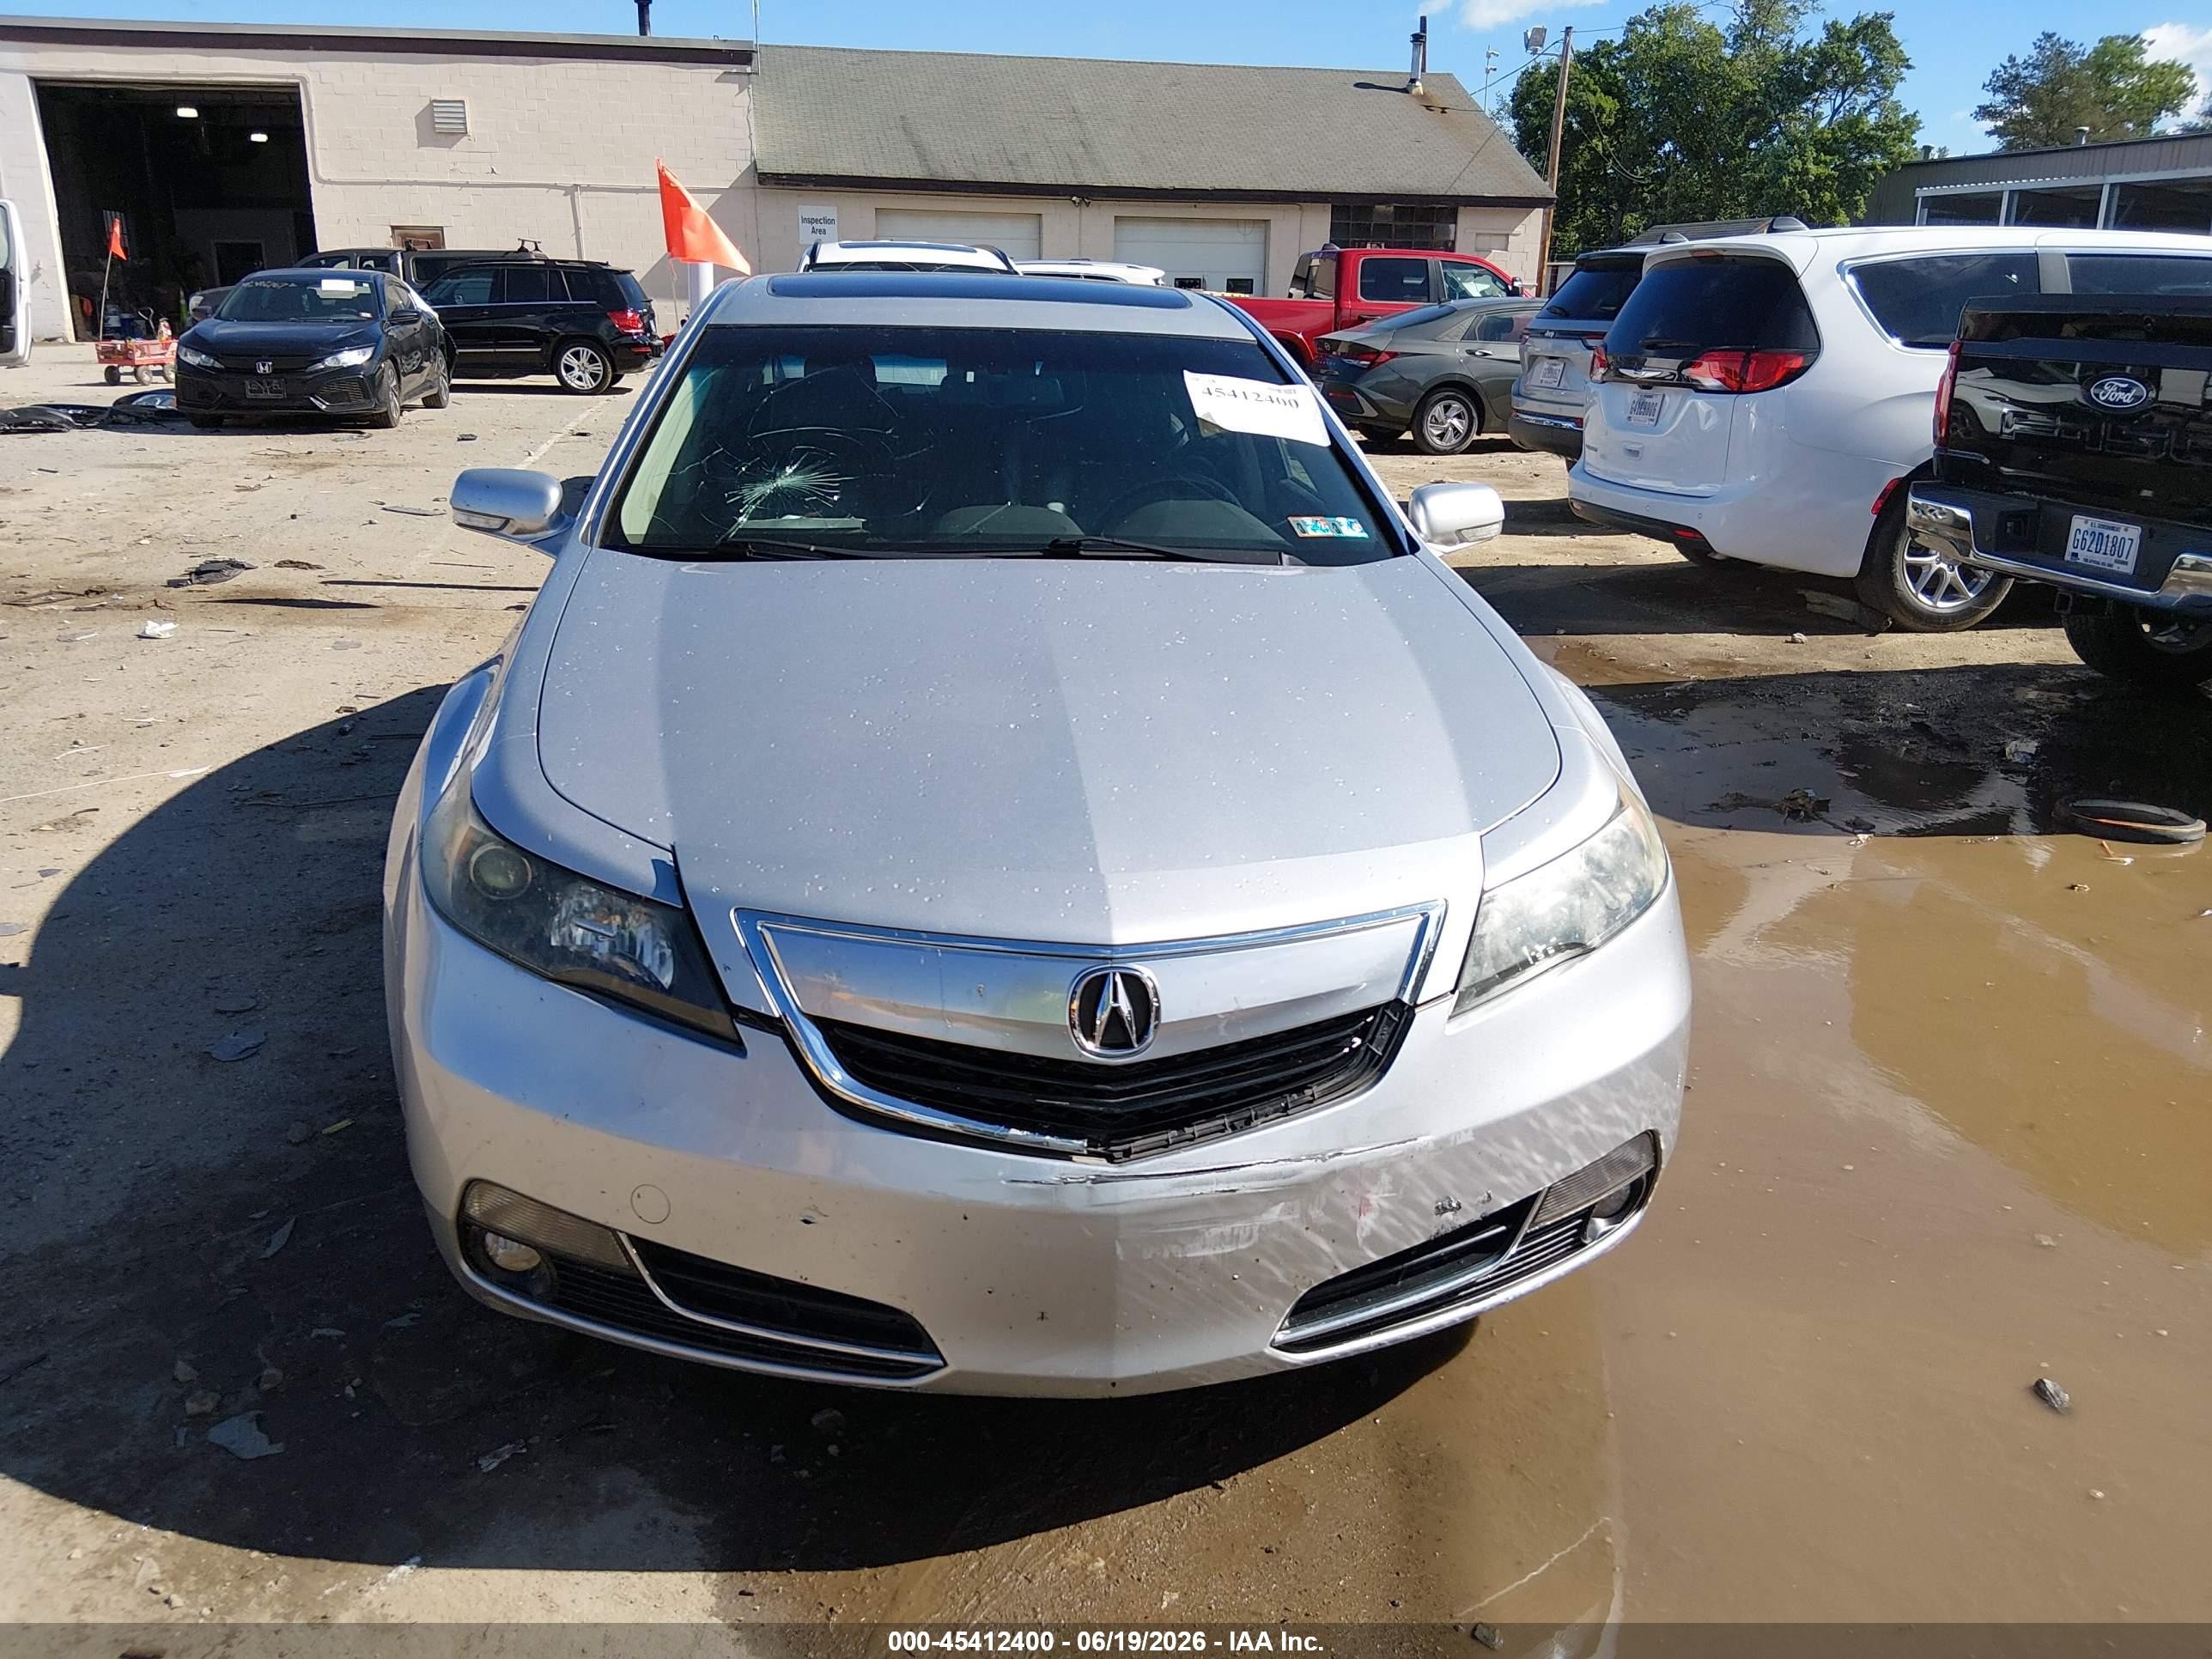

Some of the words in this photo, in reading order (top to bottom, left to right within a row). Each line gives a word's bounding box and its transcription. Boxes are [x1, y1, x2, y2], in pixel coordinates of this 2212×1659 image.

[801, 216, 836, 226] Inspection
[811, 226, 827, 235] Area
[1202, 386, 1299, 409] 45412400
[2099, 380, 2136, 404] Ford
[2072, 528, 2134, 560] G62D1807
